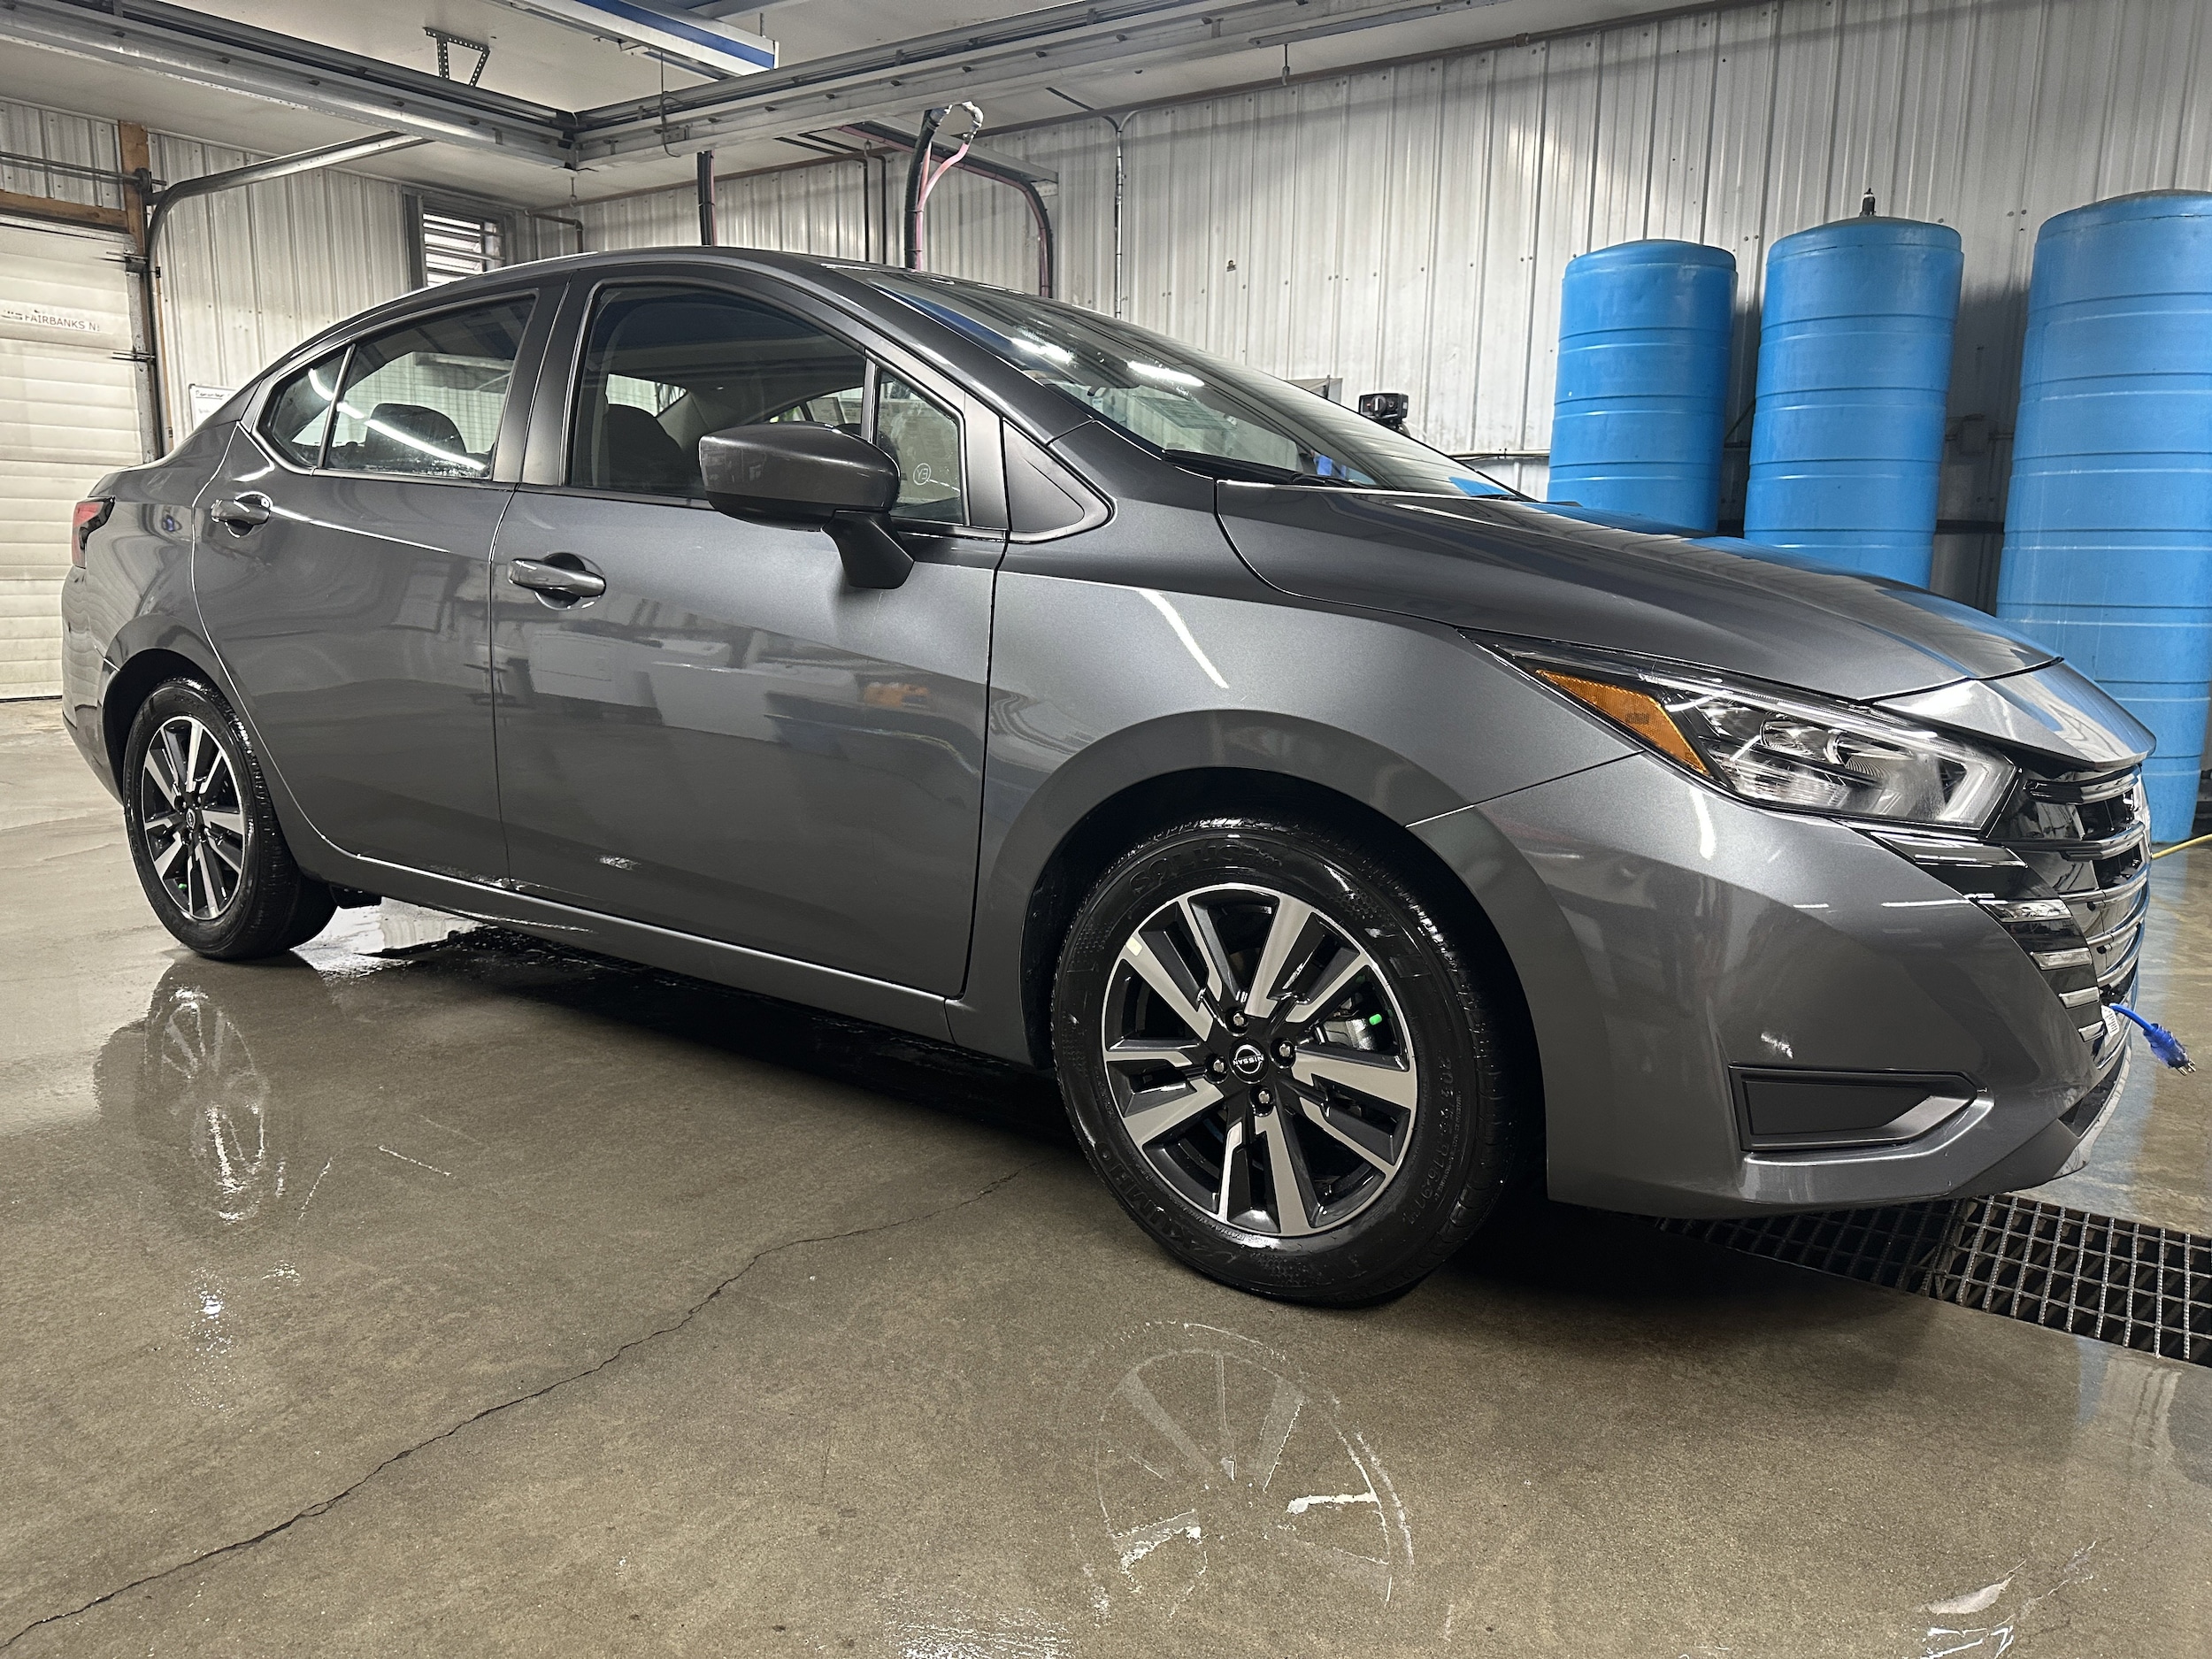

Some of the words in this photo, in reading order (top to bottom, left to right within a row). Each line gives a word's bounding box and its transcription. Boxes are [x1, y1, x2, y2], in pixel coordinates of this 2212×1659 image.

[24, 314, 86, 330] FAIRBANKS
[1233, 1055, 1264, 1065] NISSAN
[1094, 1138, 1191, 1249] KUMHO
